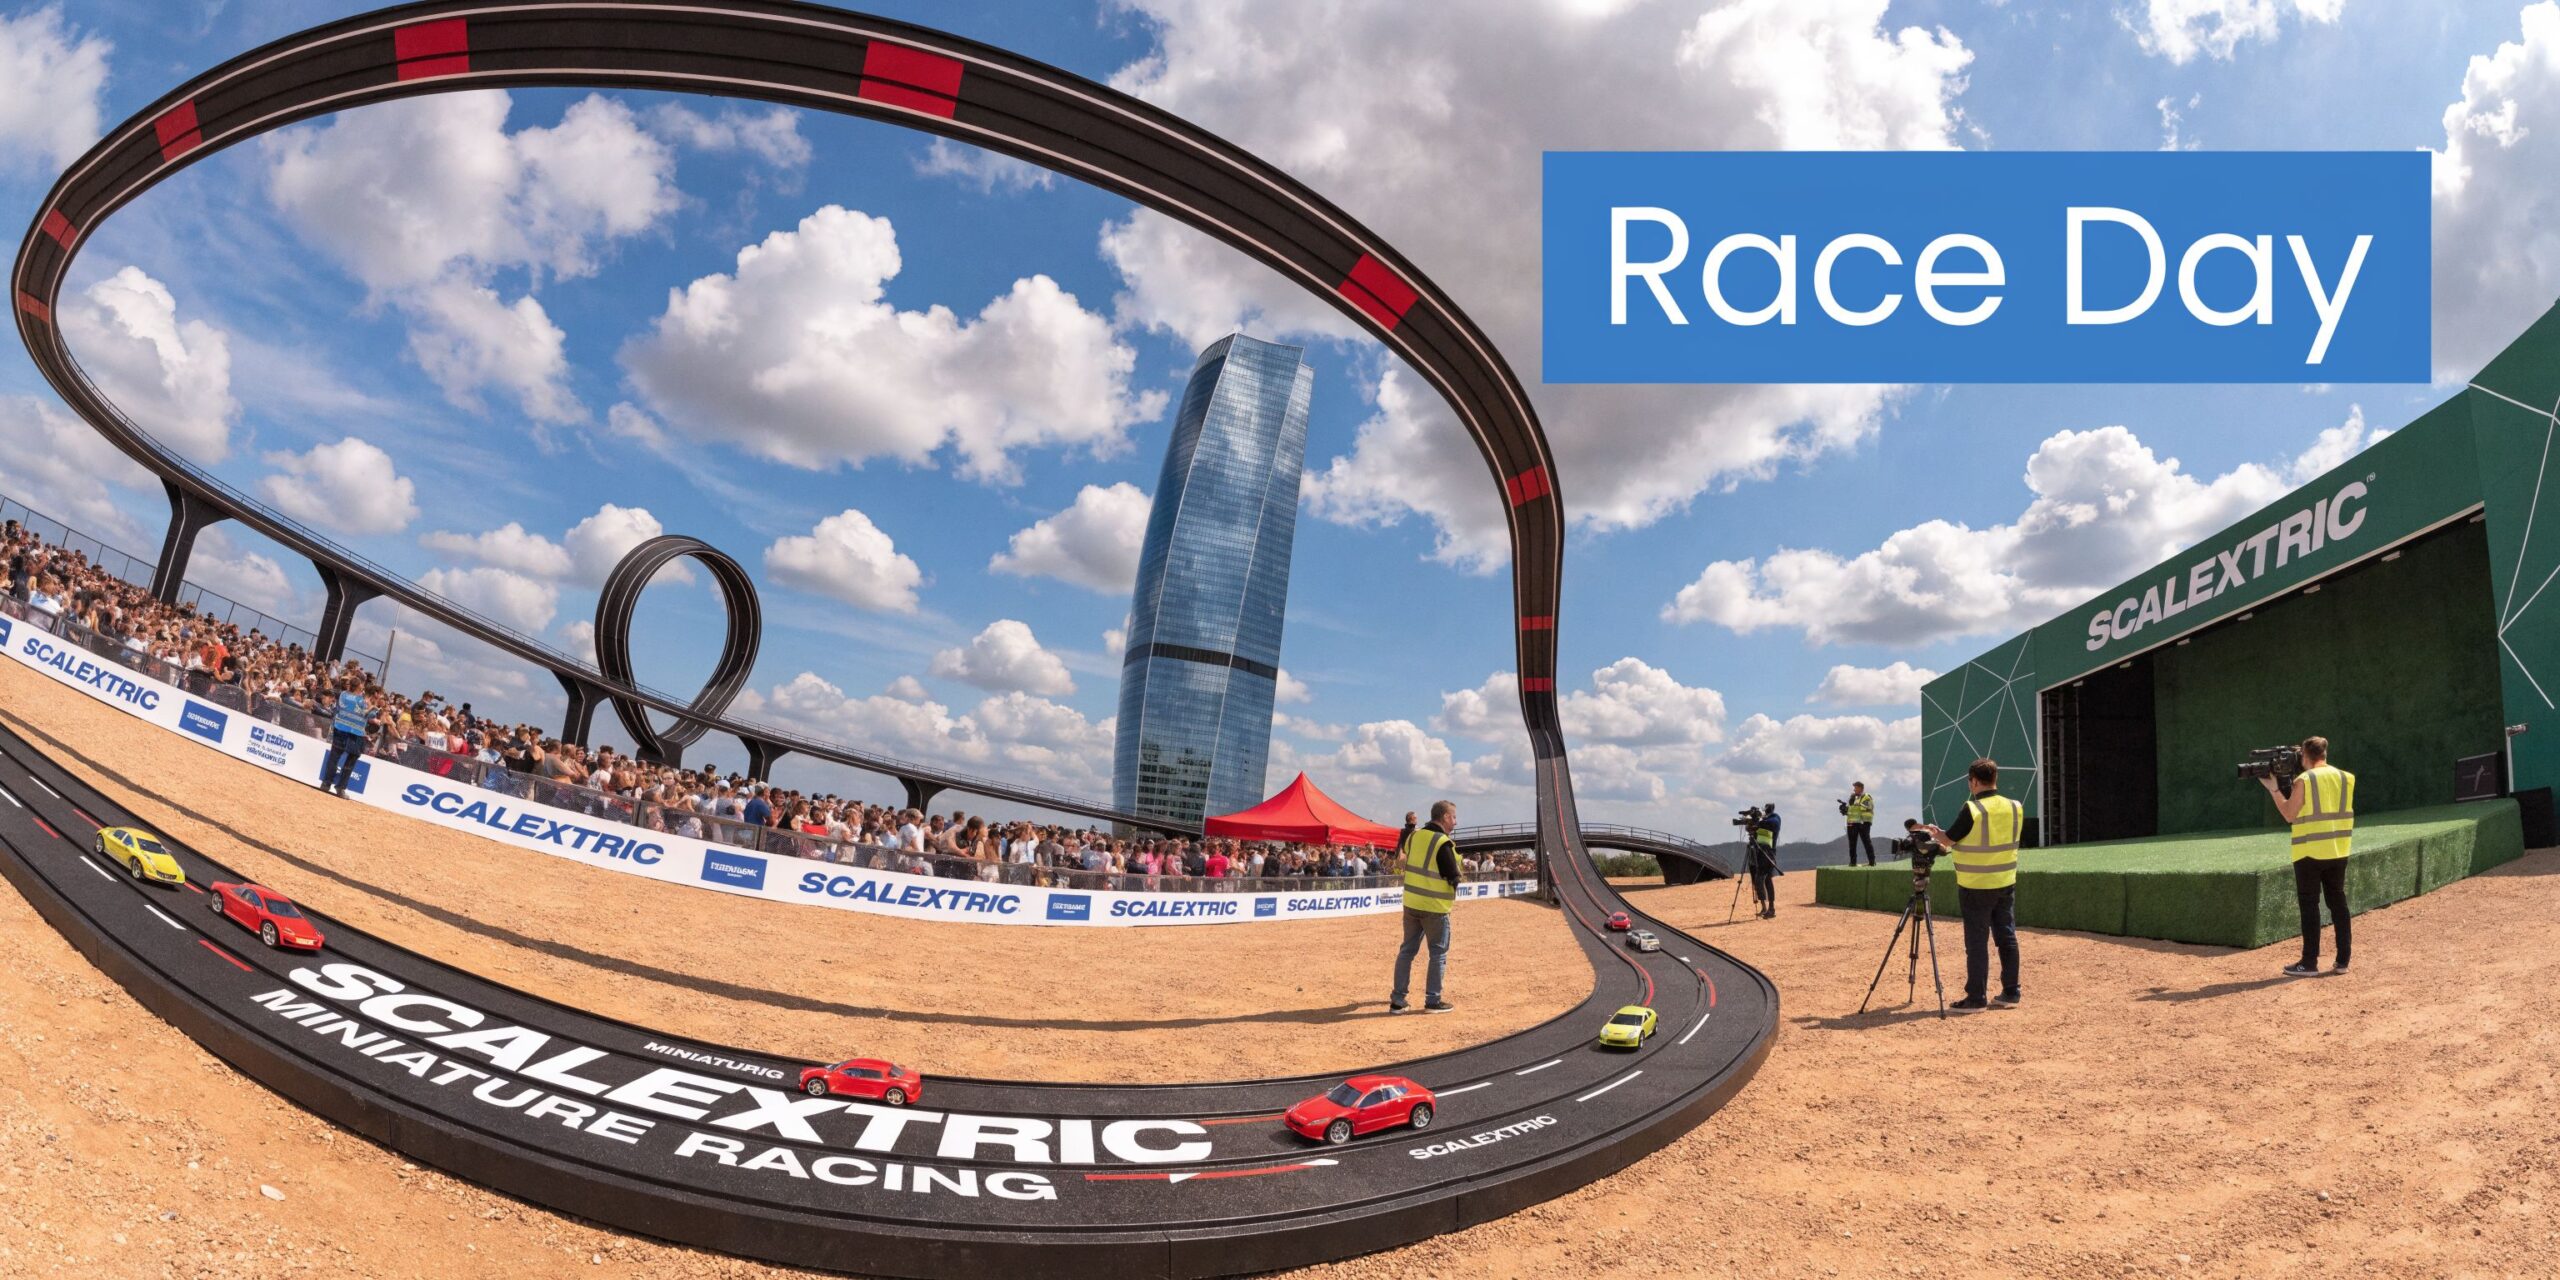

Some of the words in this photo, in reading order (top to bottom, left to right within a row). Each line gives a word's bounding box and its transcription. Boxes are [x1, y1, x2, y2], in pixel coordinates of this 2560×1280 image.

[2087, 481, 2368, 651] SCALEXTRIC
[23, 638, 160, 710] SCALEXTRIC
[401, 783, 663, 865] SCALEXTRIC
[798, 872, 1020, 914] SCALEXTRIC
[1109, 900, 1238, 918] SCALEXTRIC
[1287, 895, 1372, 912] SCALEXTRIC
[249, 988, 656, 1145] MINIATURE
[674, 1131, 1058, 1201] RACING
[288, 963, 1213, 1165] SCALEXTRIC
